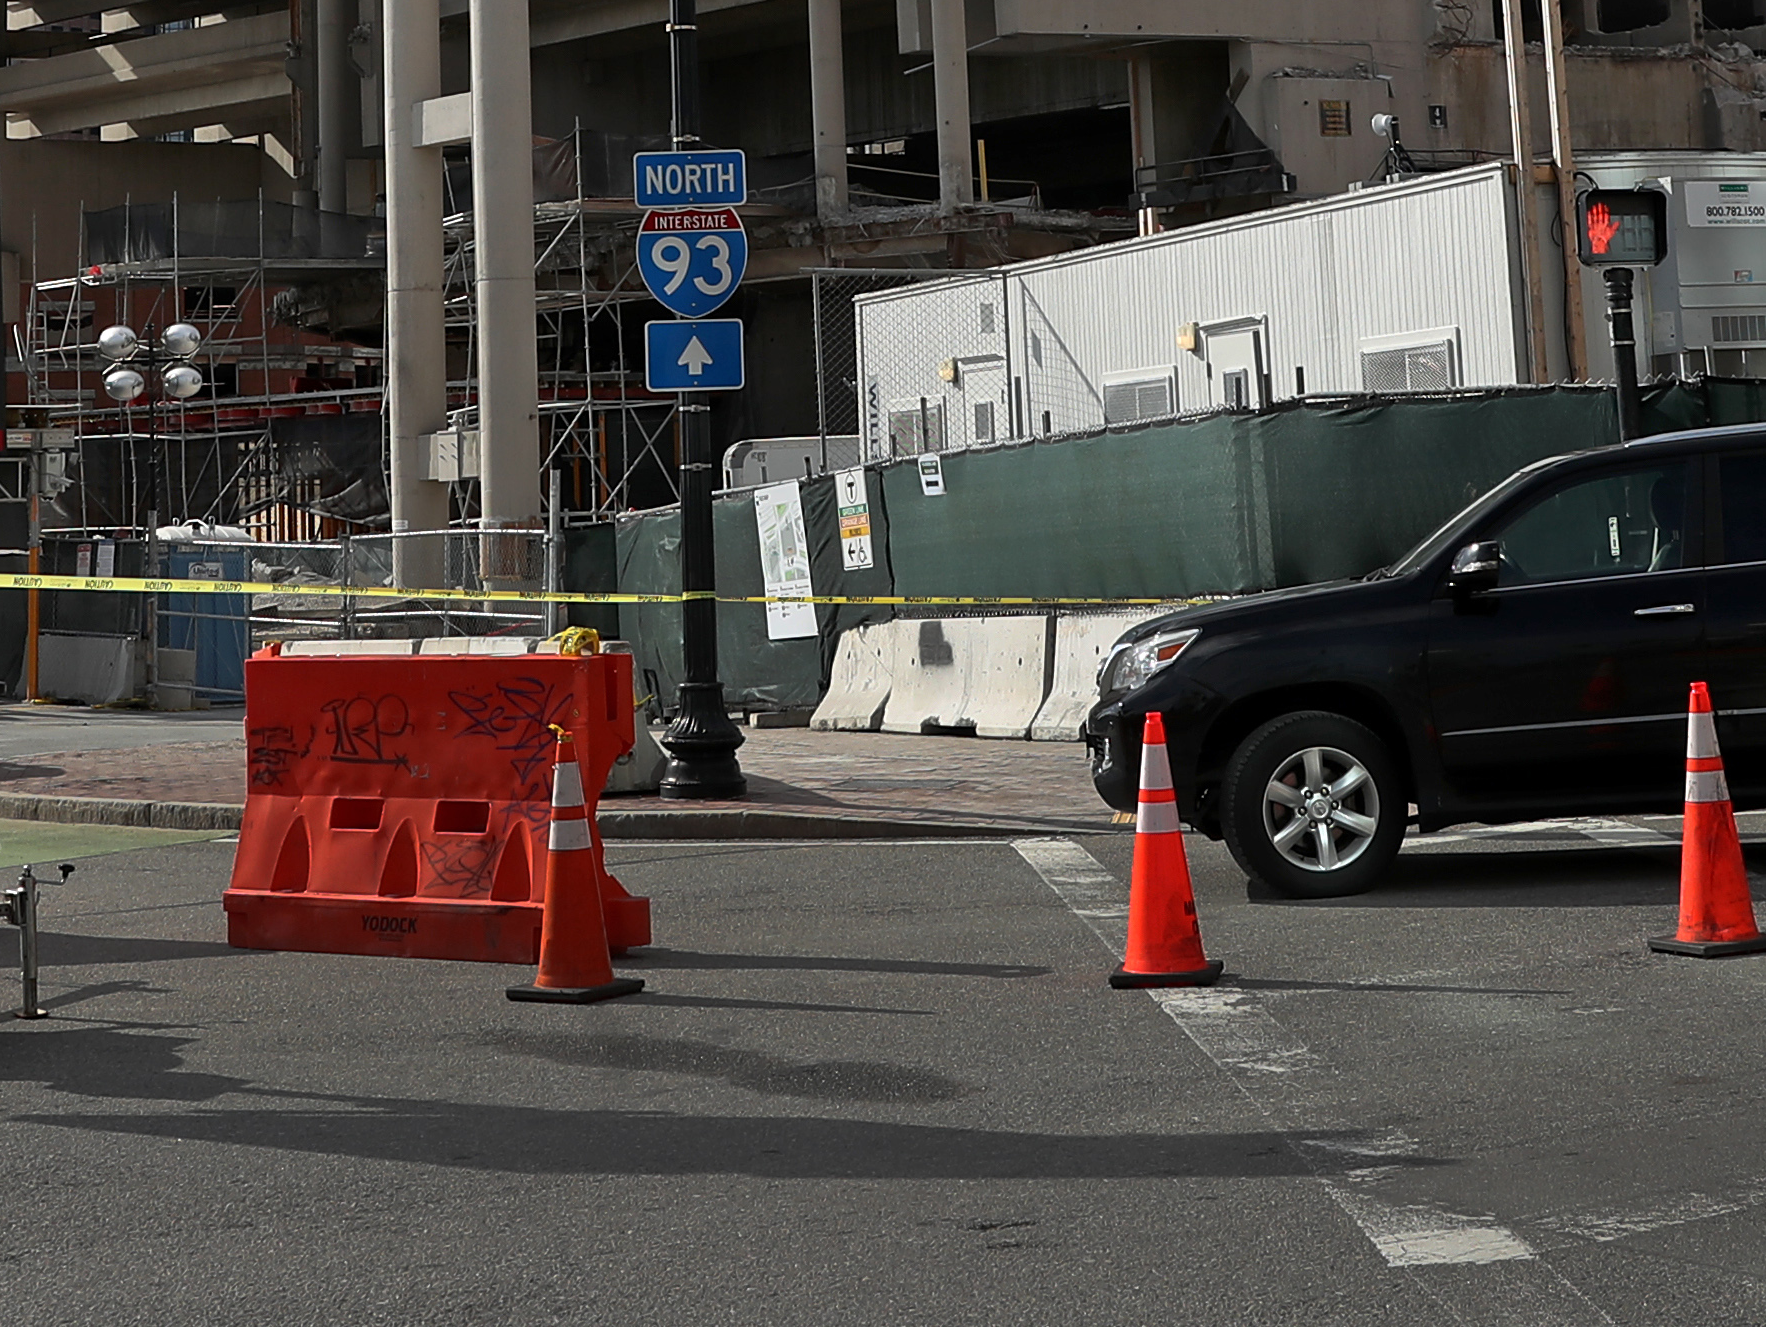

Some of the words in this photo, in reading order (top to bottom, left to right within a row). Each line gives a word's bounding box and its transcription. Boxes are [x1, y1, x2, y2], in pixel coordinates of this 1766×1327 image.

[645, 162, 735, 195] NORTH
[1706, 205, 1765, 217] 800.782.1500
[654, 214, 728, 230] INTERSTATE
[651, 235, 732, 296] 93
[193, 567, 221, 577] United
[12, 575, 43, 587] CAUTION
[84, 579, 114, 590] CAUTION
[144, 580, 173, 591] CAUTION
[213, 582, 242, 592] CAUTION
[362, 915, 418, 933] YODOCK
